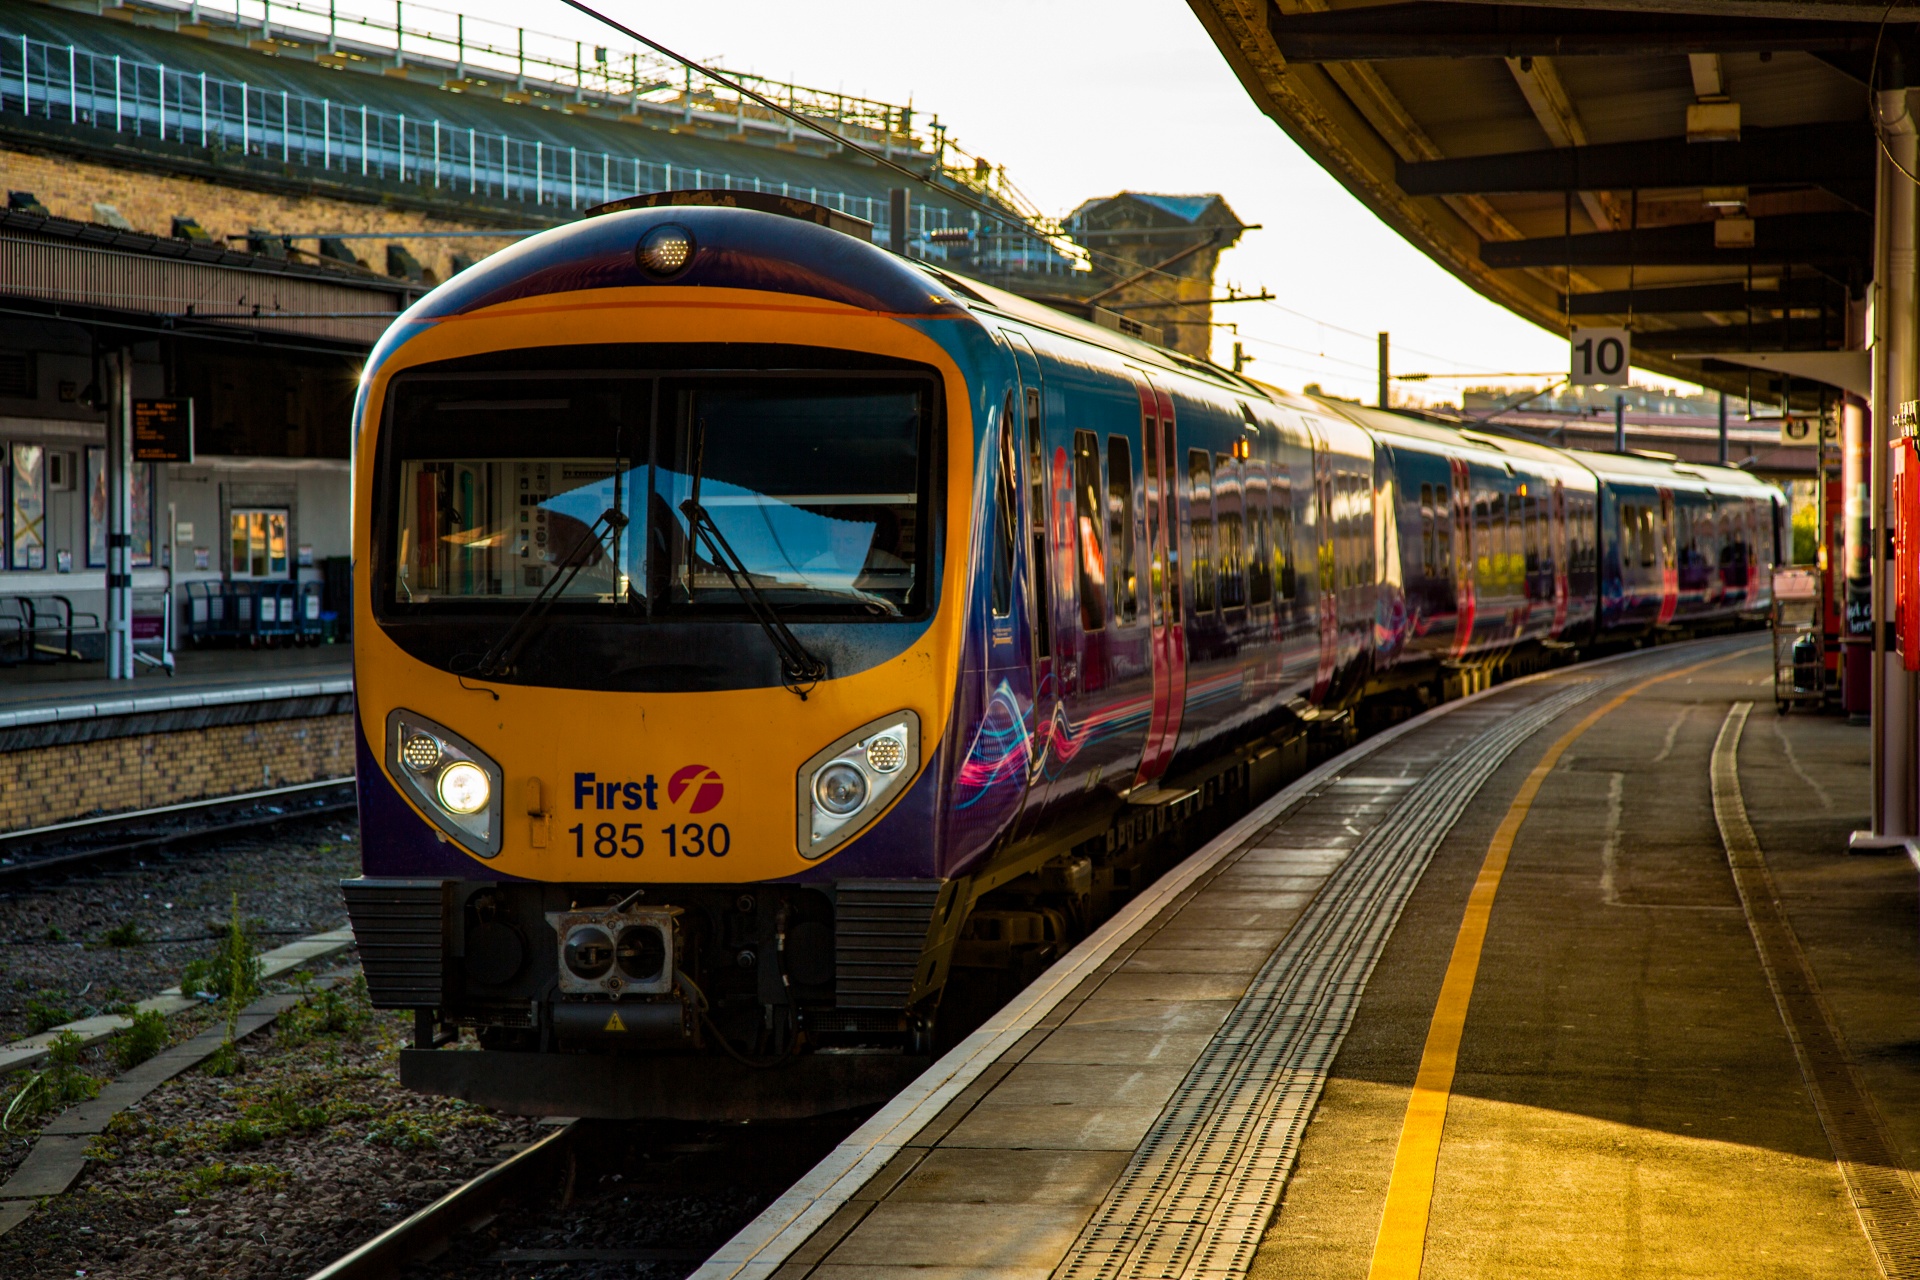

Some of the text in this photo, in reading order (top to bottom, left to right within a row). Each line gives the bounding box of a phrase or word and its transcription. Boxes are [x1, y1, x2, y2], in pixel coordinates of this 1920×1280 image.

[1575, 337, 1625, 376] 10
[574, 772, 658, 810] First
[568, 822, 731, 859] 185 130
